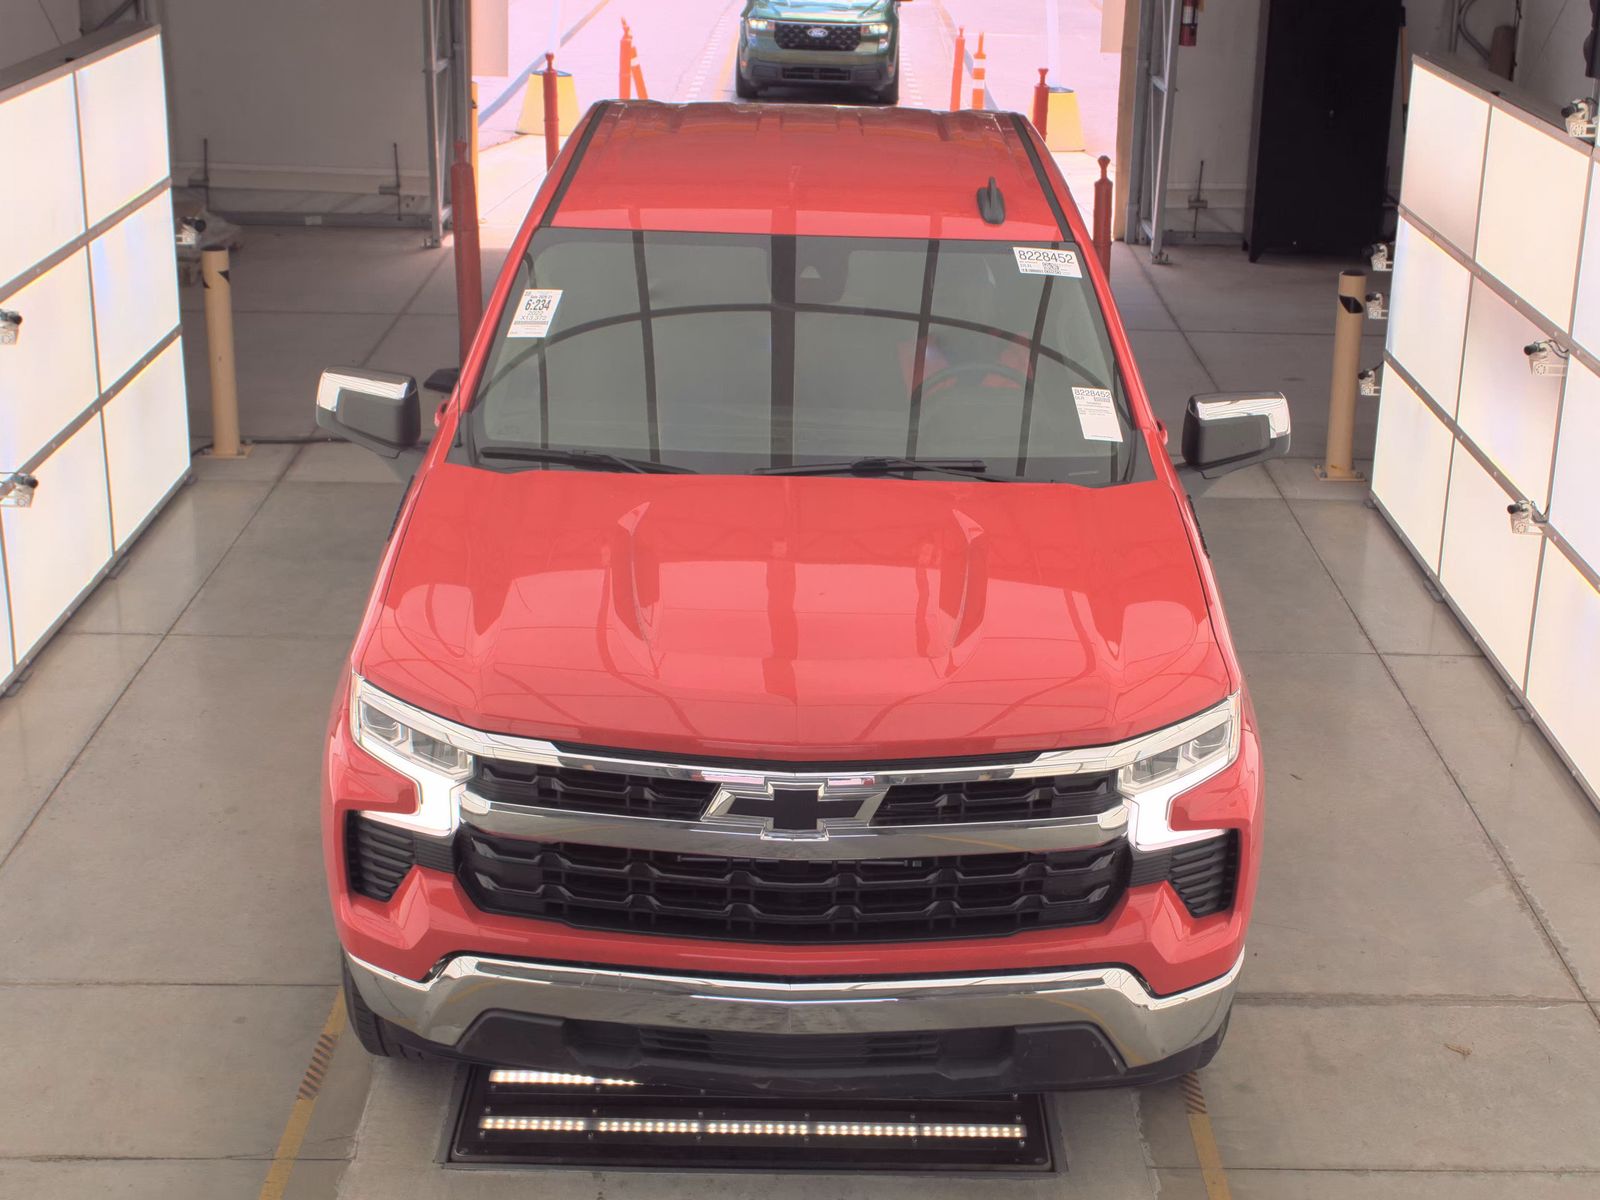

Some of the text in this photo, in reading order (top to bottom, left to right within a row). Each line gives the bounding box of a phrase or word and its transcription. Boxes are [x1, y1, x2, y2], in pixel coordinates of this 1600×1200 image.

[1018, 249, 1075, 264] 8228452
[525, 299, 551, 311] 6:234
[1074, 389, 1111, 399] 8228452
